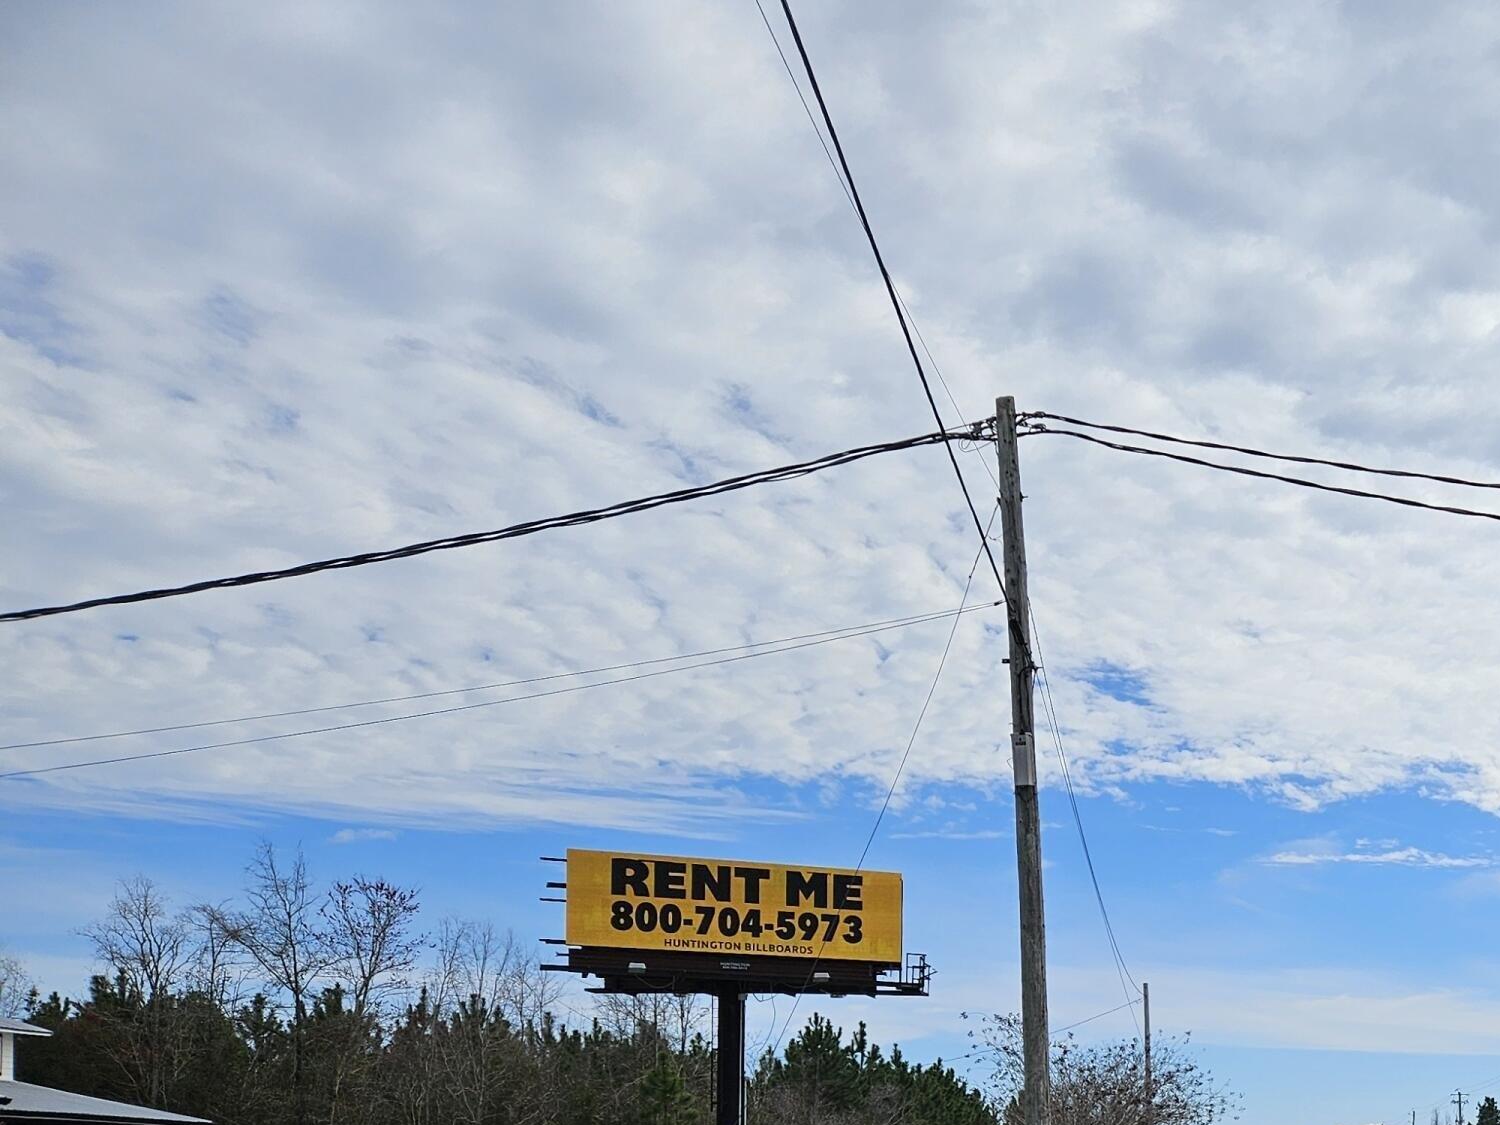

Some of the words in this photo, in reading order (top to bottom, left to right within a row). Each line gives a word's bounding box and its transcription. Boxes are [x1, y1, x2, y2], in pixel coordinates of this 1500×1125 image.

[611, 858, 770, 904] RENT
[786, 870, 863, 910] ME
[610, 900, 863, 944] 800-704-5973
[664, 938, 741, 951] HUNTINGTON
[745, 942, 813, 955] BILLBOARDS
